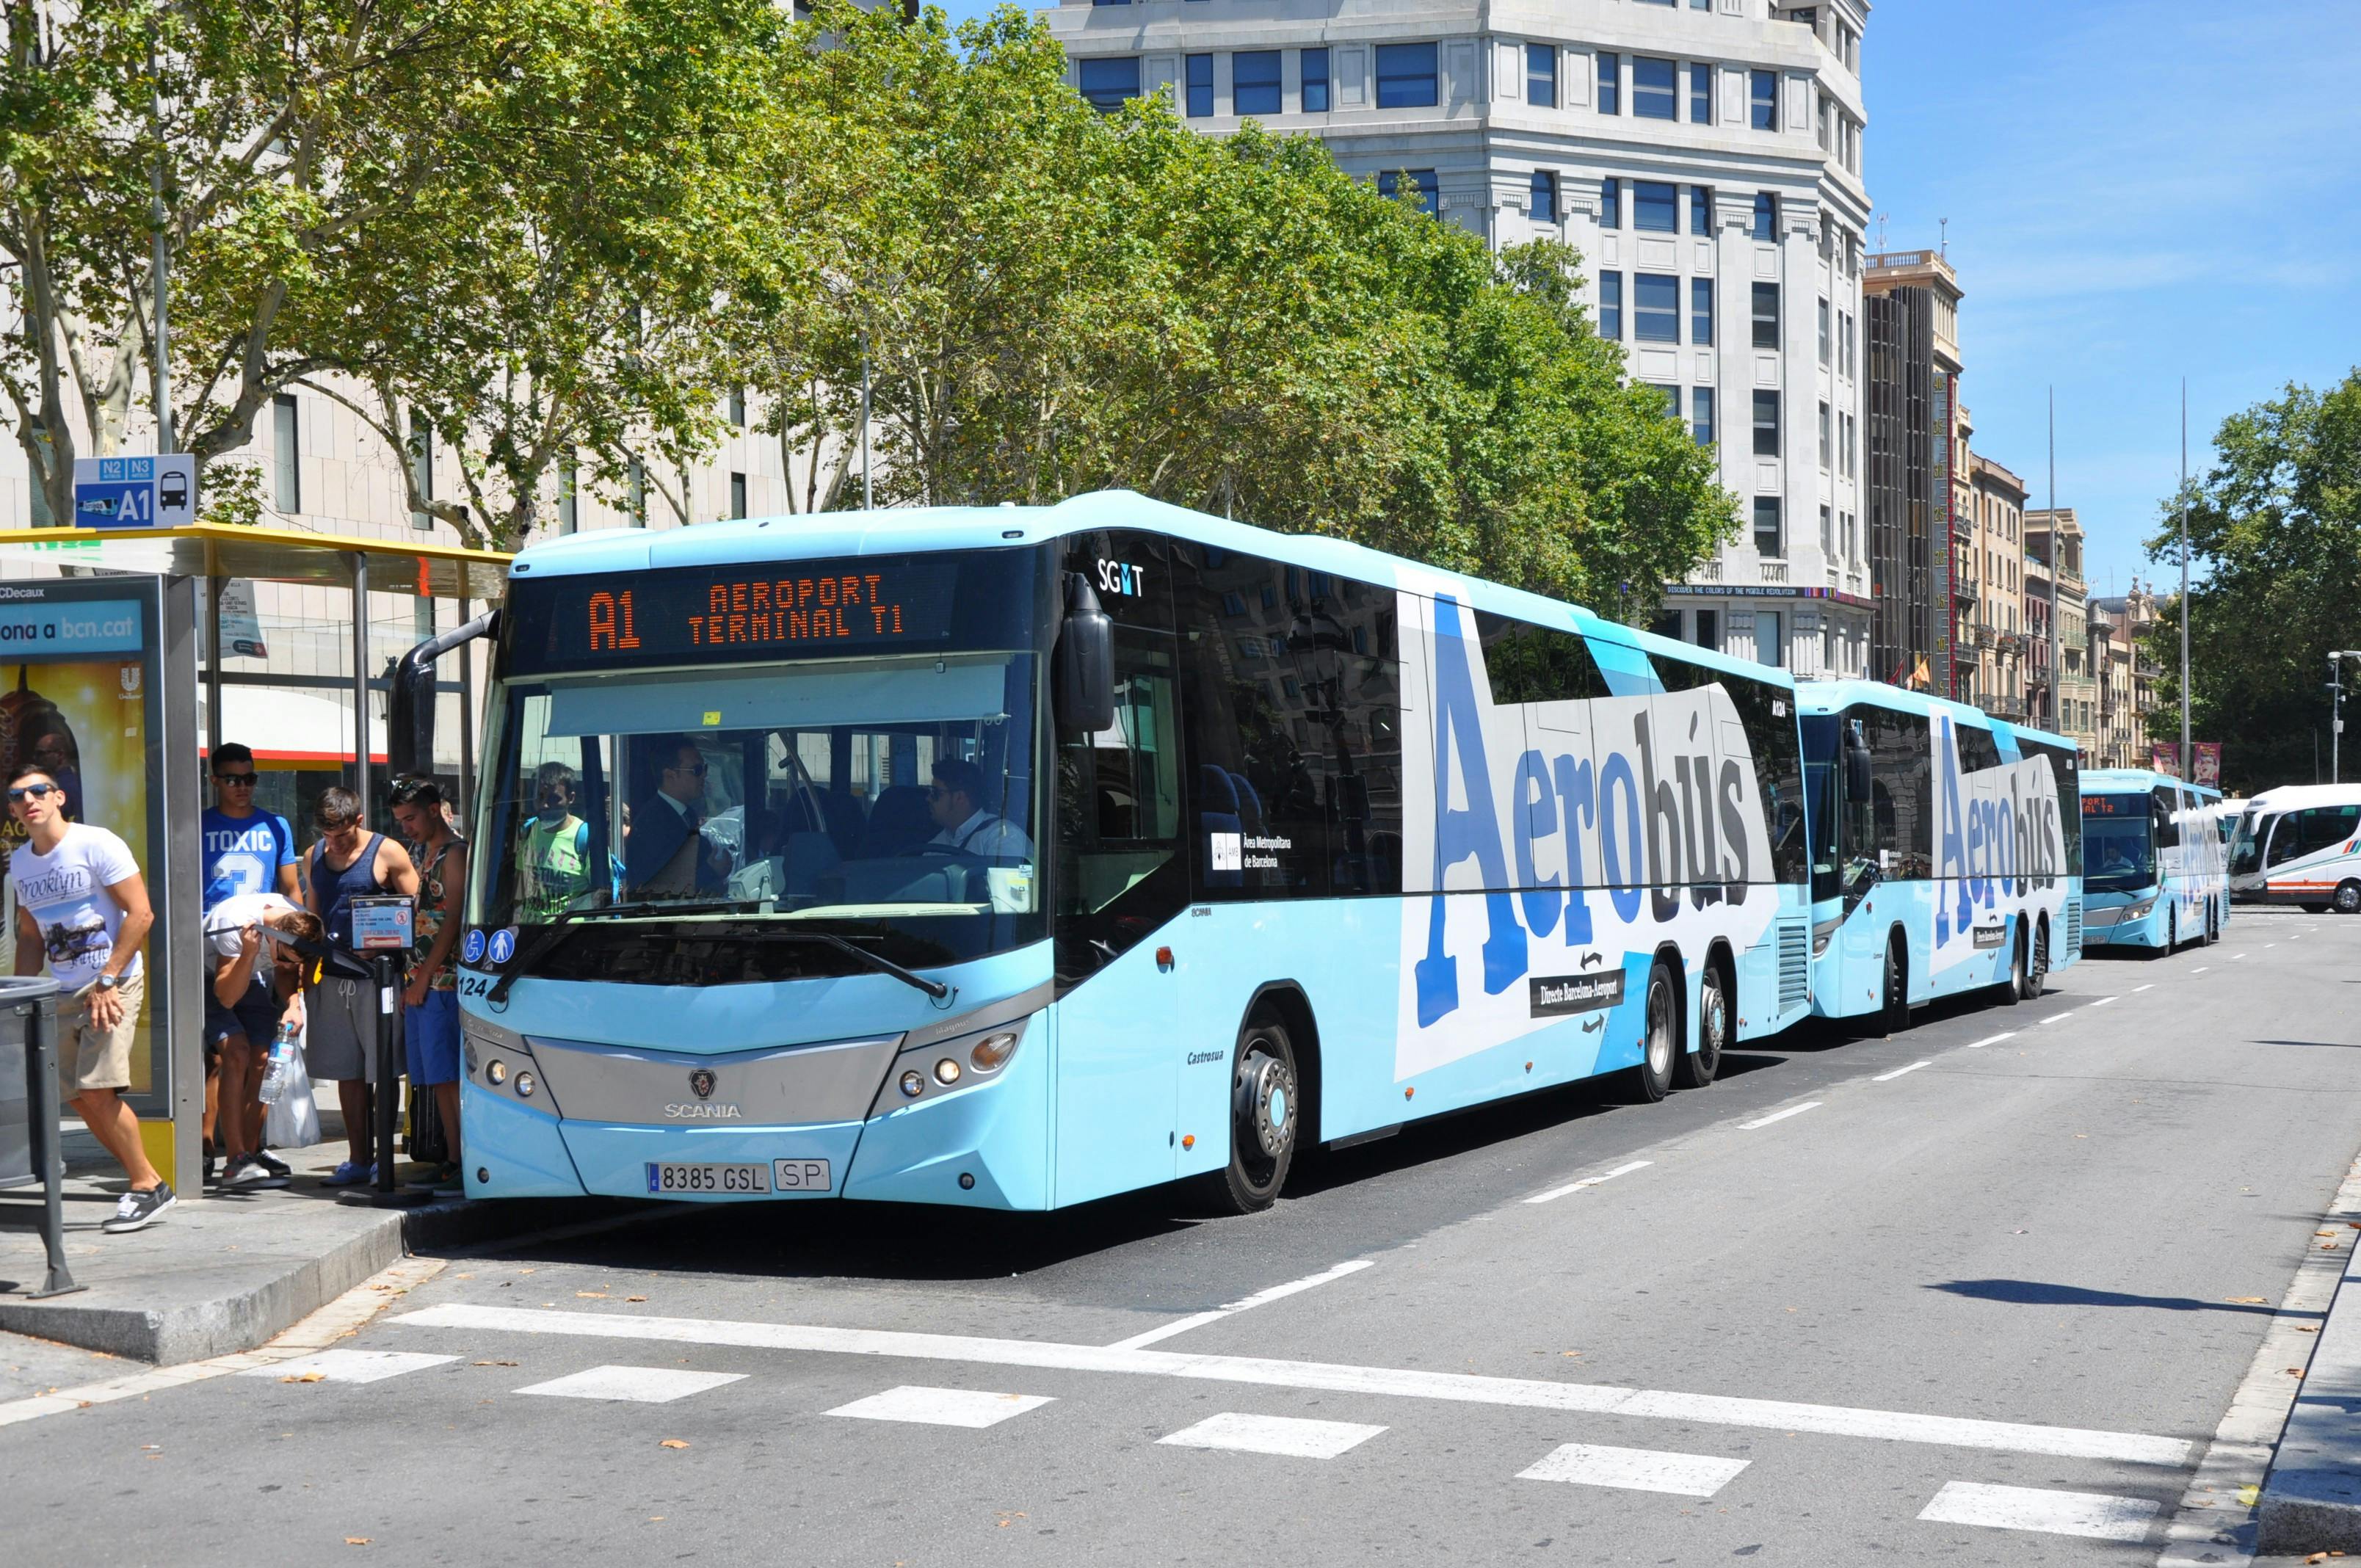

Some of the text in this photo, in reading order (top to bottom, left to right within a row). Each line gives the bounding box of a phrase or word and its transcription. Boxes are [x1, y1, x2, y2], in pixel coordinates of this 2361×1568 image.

[1933, 376, 1944, 391] 40
[1933, 420, 1943, 435] 35
[104, 460, 149, 473] N2 N3
[1934, 464, 1943, 477] 30
[117, 489, 149, 520] A1
[1934, 507, 1944, 522] 25
[1934, 551, 1944, 565] 20
[710, 575, 880, 613] AEROPORT
[1667, 586, 1796, 596] DISCOVER THE COLORS OF THE MOBILE REVOLUTION
[1936, 594, 1945, 609] 15
[43, 623, 56, 639] a
[62, 616, 134, 639] bcn.cat
[589, 590, 640, 650] A1
[688, 604, 903, 645] TERMINAL T1
[1937, 637, 1945, 651] 10
[1939, 681, 1944, 695] 5
[1772, 700, 1785, 718] A124
[1415, 592, 1749, 1028] Aerobús
[2102, 805, 2114, 813] T2
[1936, 715, 2055, 950] Aerobús
[206, 830, 272, 852] TOXIC
[1243, 832, 1291, 852] Àrea Metropolitana
[1228, 847, 1238, 857] AMB
[1244, 855, 1277, 868] de Barcelona
[18, 865, 83, 899] Brooklyn
[459, 976, 488, 997] 124
[1540, 979, 1617, 1005] Directe Barcelona-Aeroport
[1187, 1050, 1224, 1065] Castrosua
[664, 1103, 742, 1118] SCANIA
[663, 1167, 715, 1189] 8385
[724, 1168, 764, 1190] GSL
[783, 1164, 821, 1186] SP
